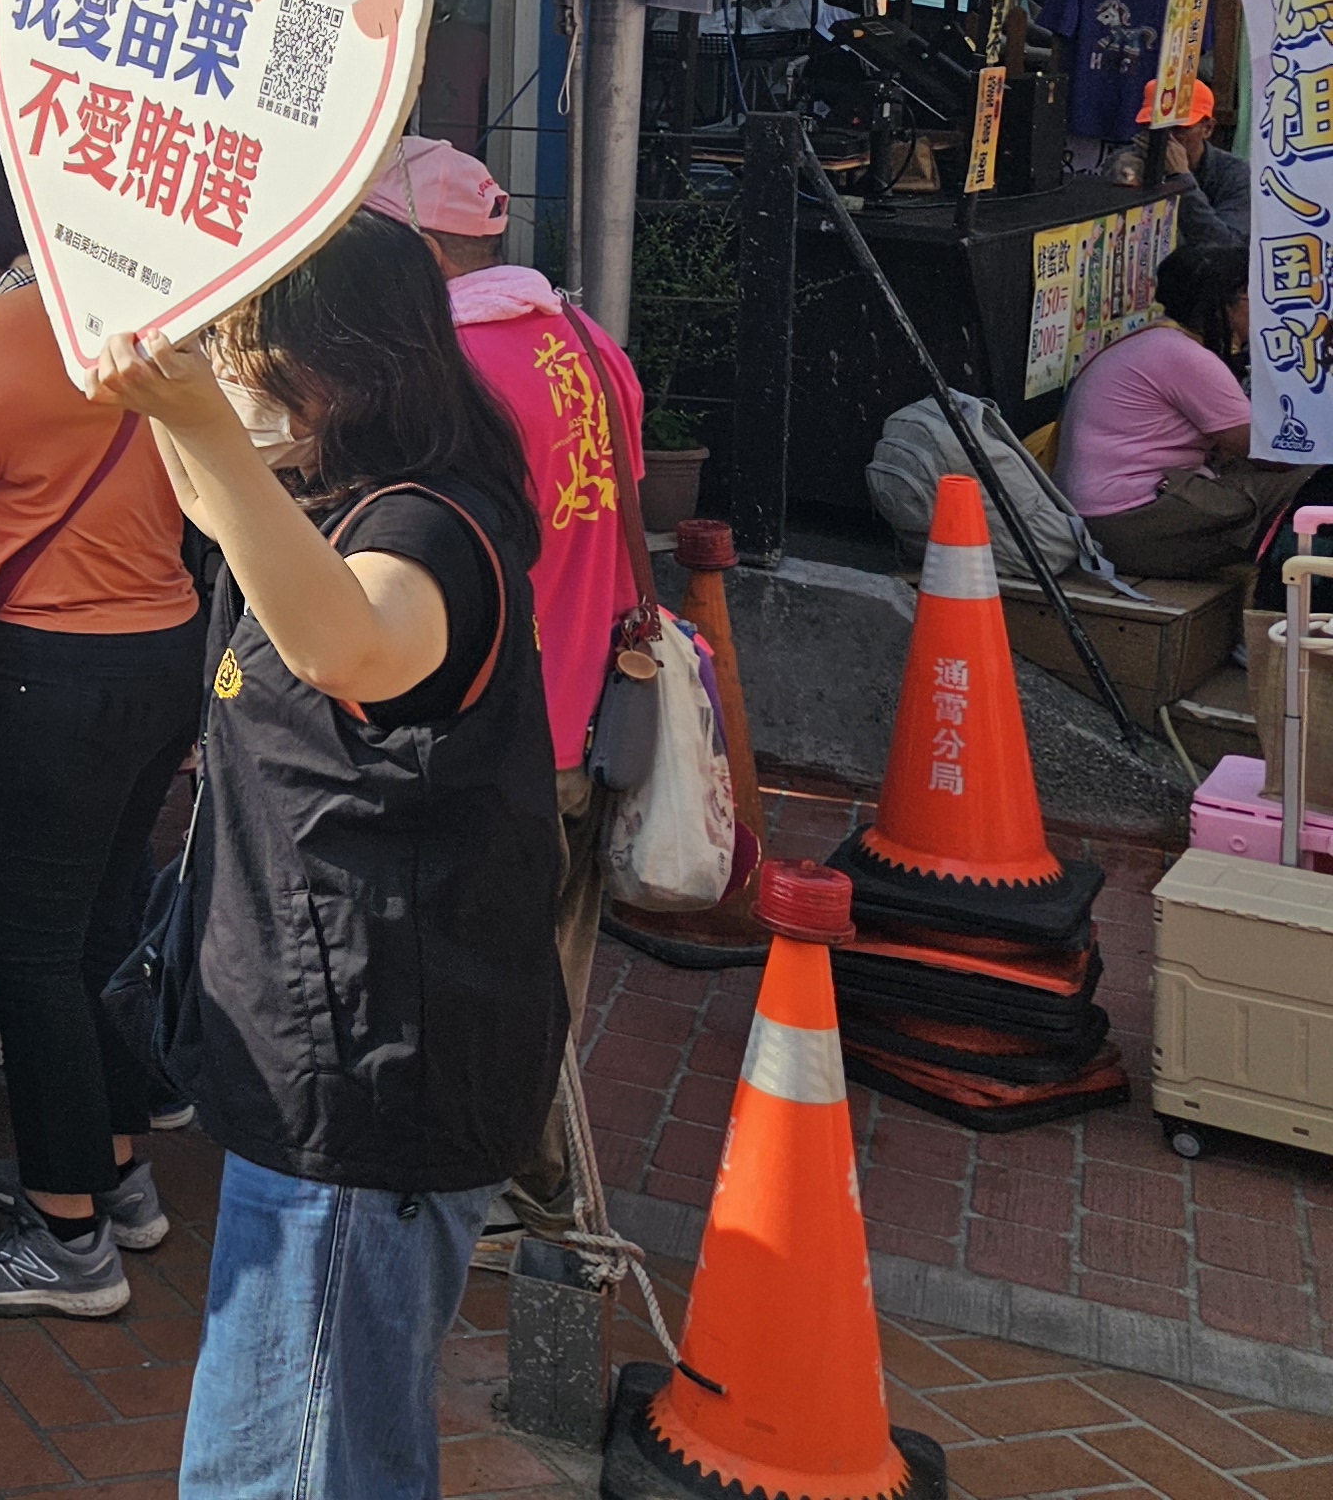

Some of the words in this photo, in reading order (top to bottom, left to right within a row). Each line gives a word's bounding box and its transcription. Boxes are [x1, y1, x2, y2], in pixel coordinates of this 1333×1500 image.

[19, 58, 264, 248] 不愛賄選
[929, 657, 970, 796] 通霄分局
